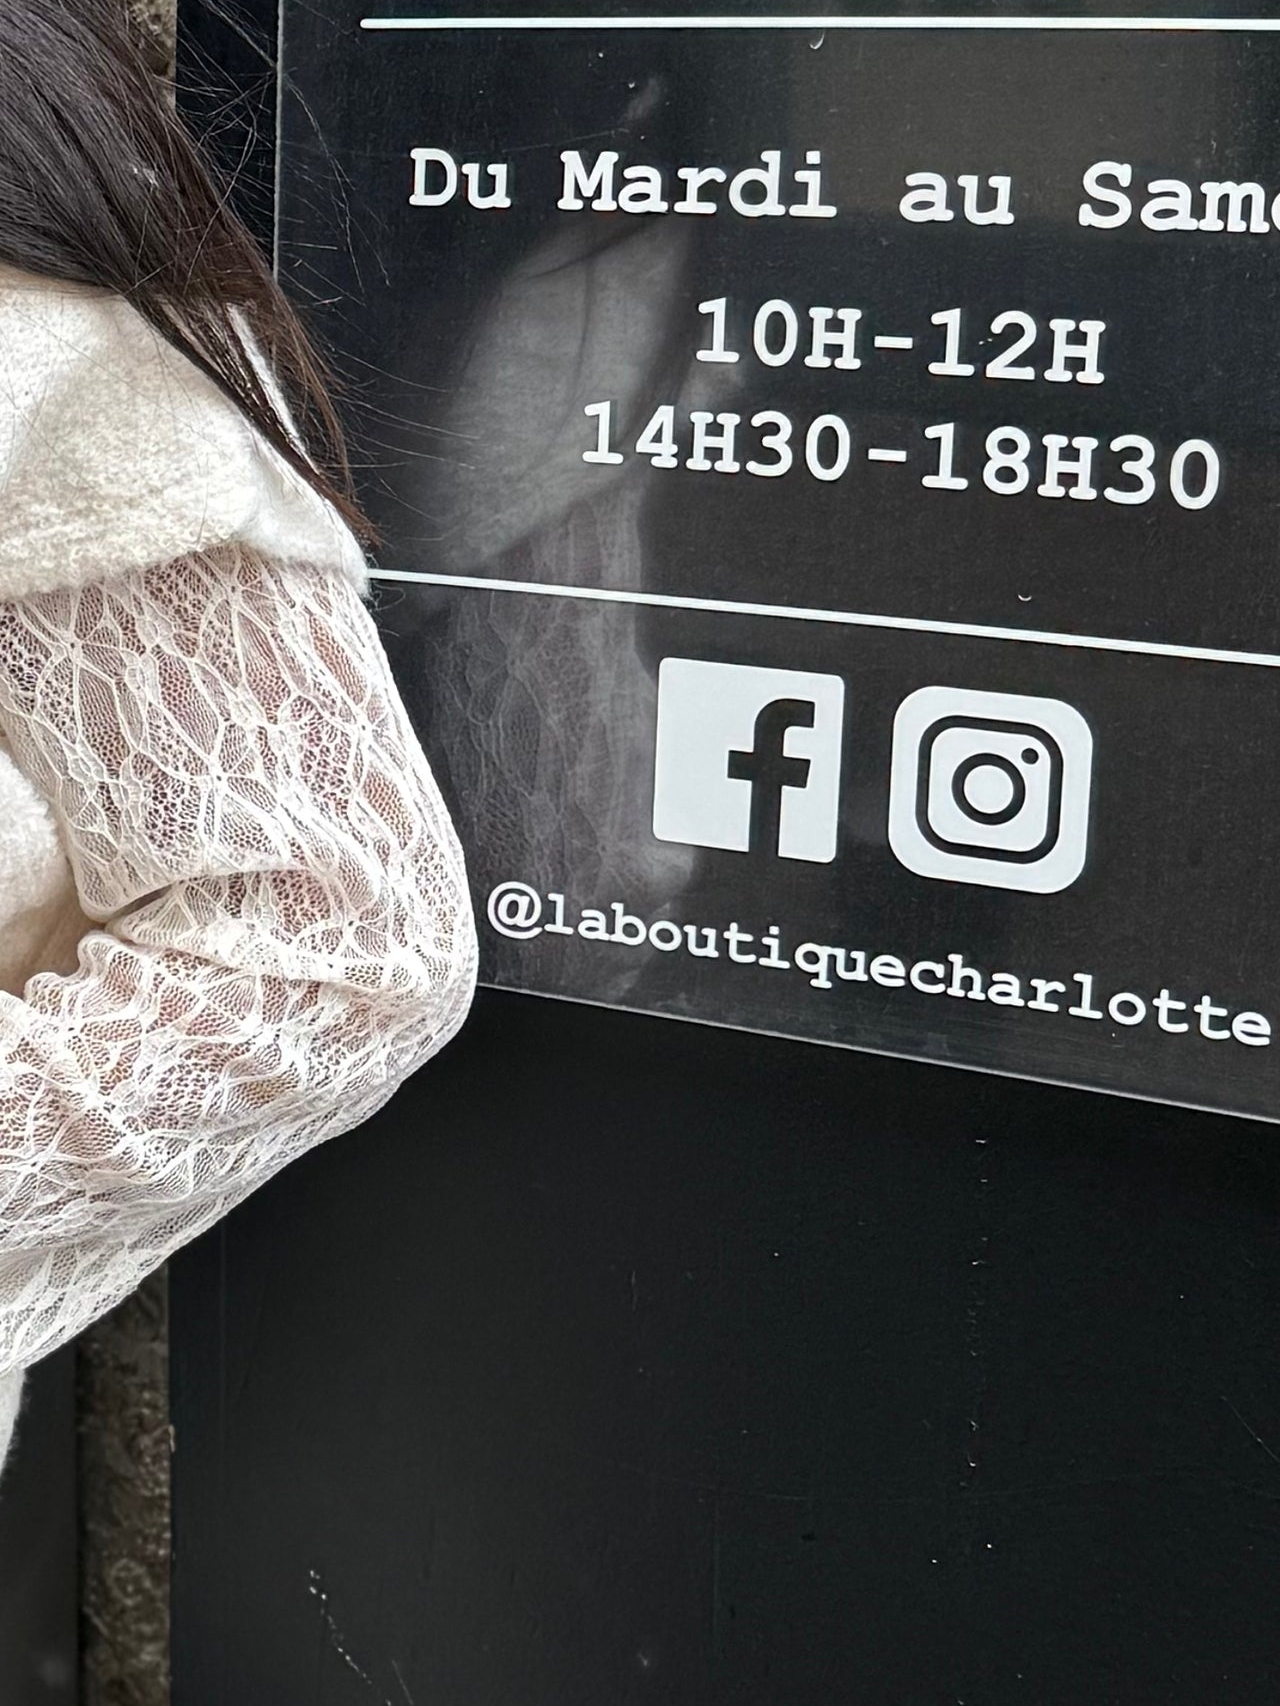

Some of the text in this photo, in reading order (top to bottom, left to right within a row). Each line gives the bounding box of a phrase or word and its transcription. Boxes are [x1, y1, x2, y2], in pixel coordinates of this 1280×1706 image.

[408, 147, 1280, 234] Du Mardi au Sam
[695, 297, 1106, 385] 10H-12H
[581, 400, 1220, 511] 14H30-18H30
[486, 879, 1272, 1048] @laboutiquecharlotte
